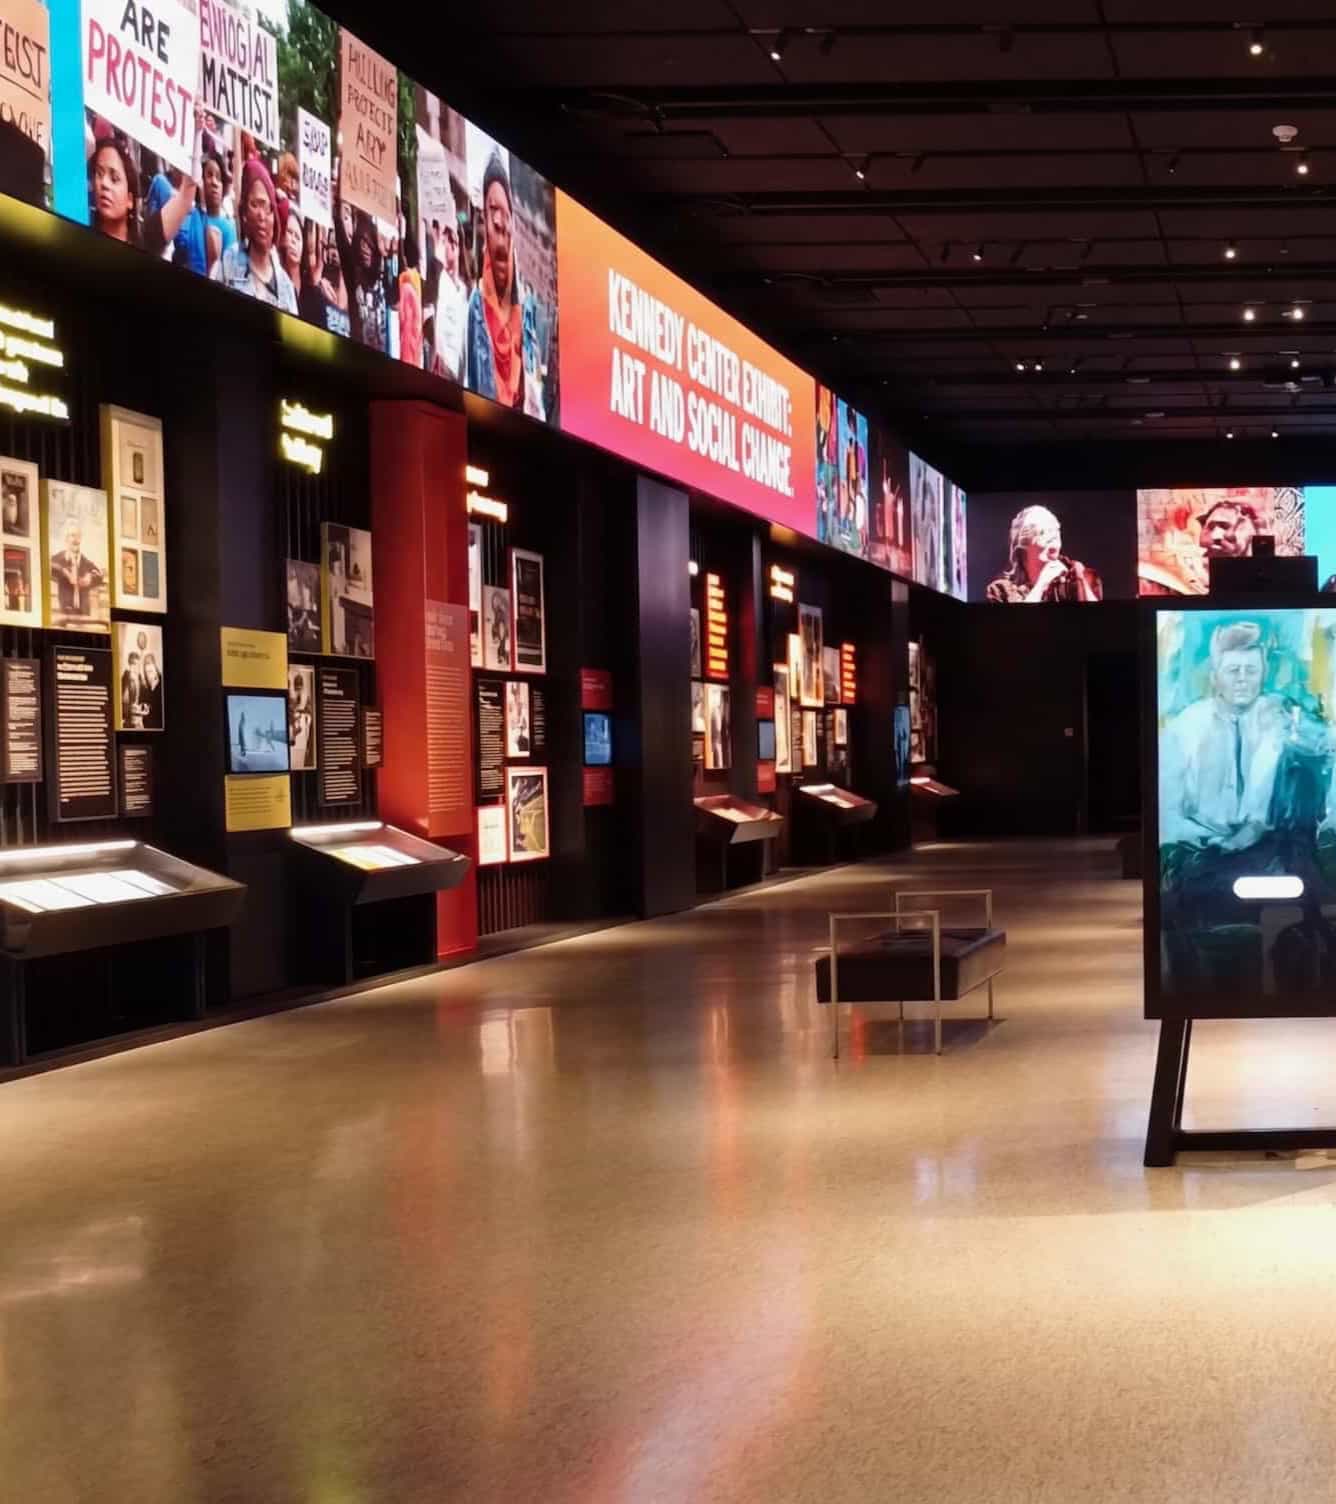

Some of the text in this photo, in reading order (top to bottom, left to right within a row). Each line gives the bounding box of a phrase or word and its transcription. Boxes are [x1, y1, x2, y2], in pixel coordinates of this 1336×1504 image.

[88, 18, 193, 148] PROTEST
[120, 0, 171, 64] ARE
[608, 268, 685, 370] KENNEDY
[687, 322, 740, 407] CENTER
[610, 347, 646, 424] ART
[650, 369, 685, 444] AND
[687, 390, 740, 472] SOCIAL
